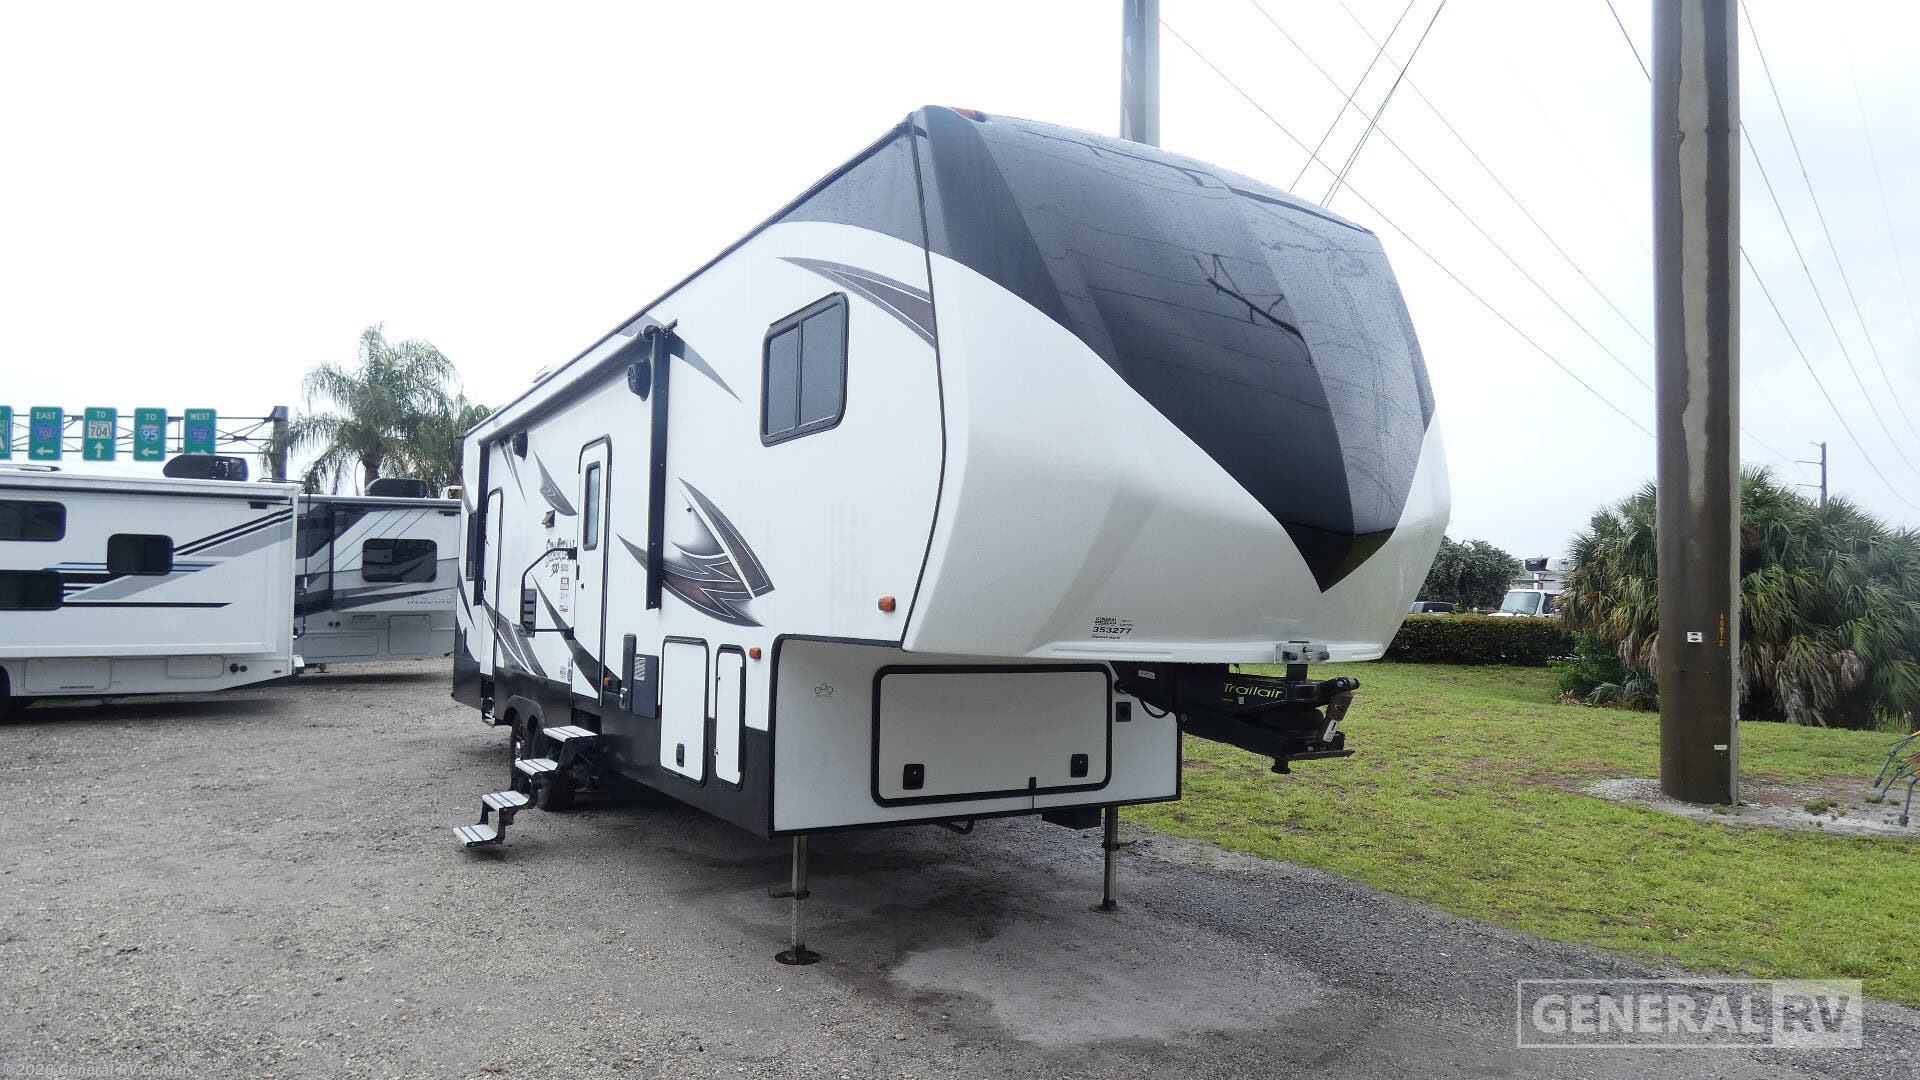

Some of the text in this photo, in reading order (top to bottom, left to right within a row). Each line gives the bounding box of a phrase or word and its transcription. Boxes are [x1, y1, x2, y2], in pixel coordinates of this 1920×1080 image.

[36, 411, 57, 420] EAST
[96, 410, 106, 419] TO
[144, 413, 157, 421] TO
[190, 412, 210, 420] WEST
[90, 426, 107, 436] 704
[142, 429, 158, 441] 95
[1092, 625, 1133, 634] 353277
[1223, 683, 1283, 699] Trailair
